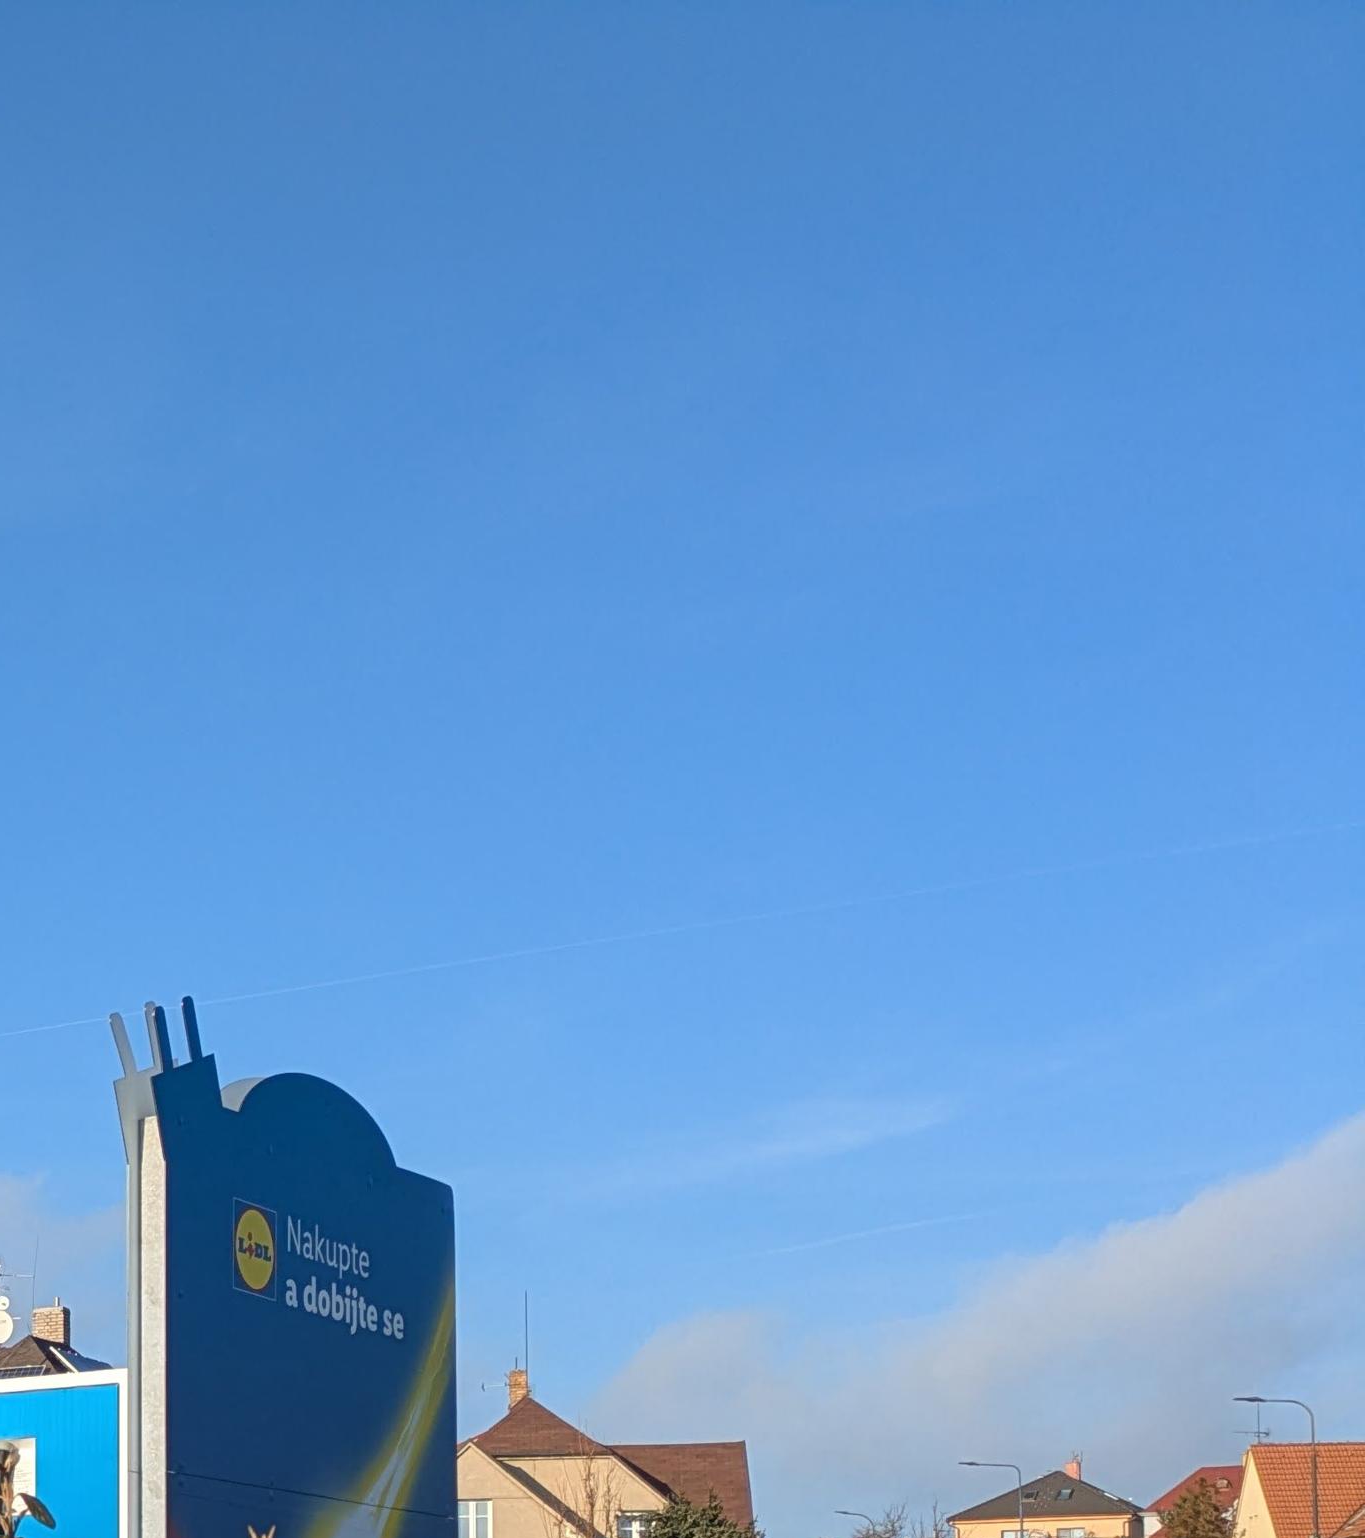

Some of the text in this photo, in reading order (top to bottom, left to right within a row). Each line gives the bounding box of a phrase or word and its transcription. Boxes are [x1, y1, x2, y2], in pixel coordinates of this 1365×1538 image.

[287, 1215, 370, 1279] Nakupte
[285, 1276, 404, 1340] a dobijte se
